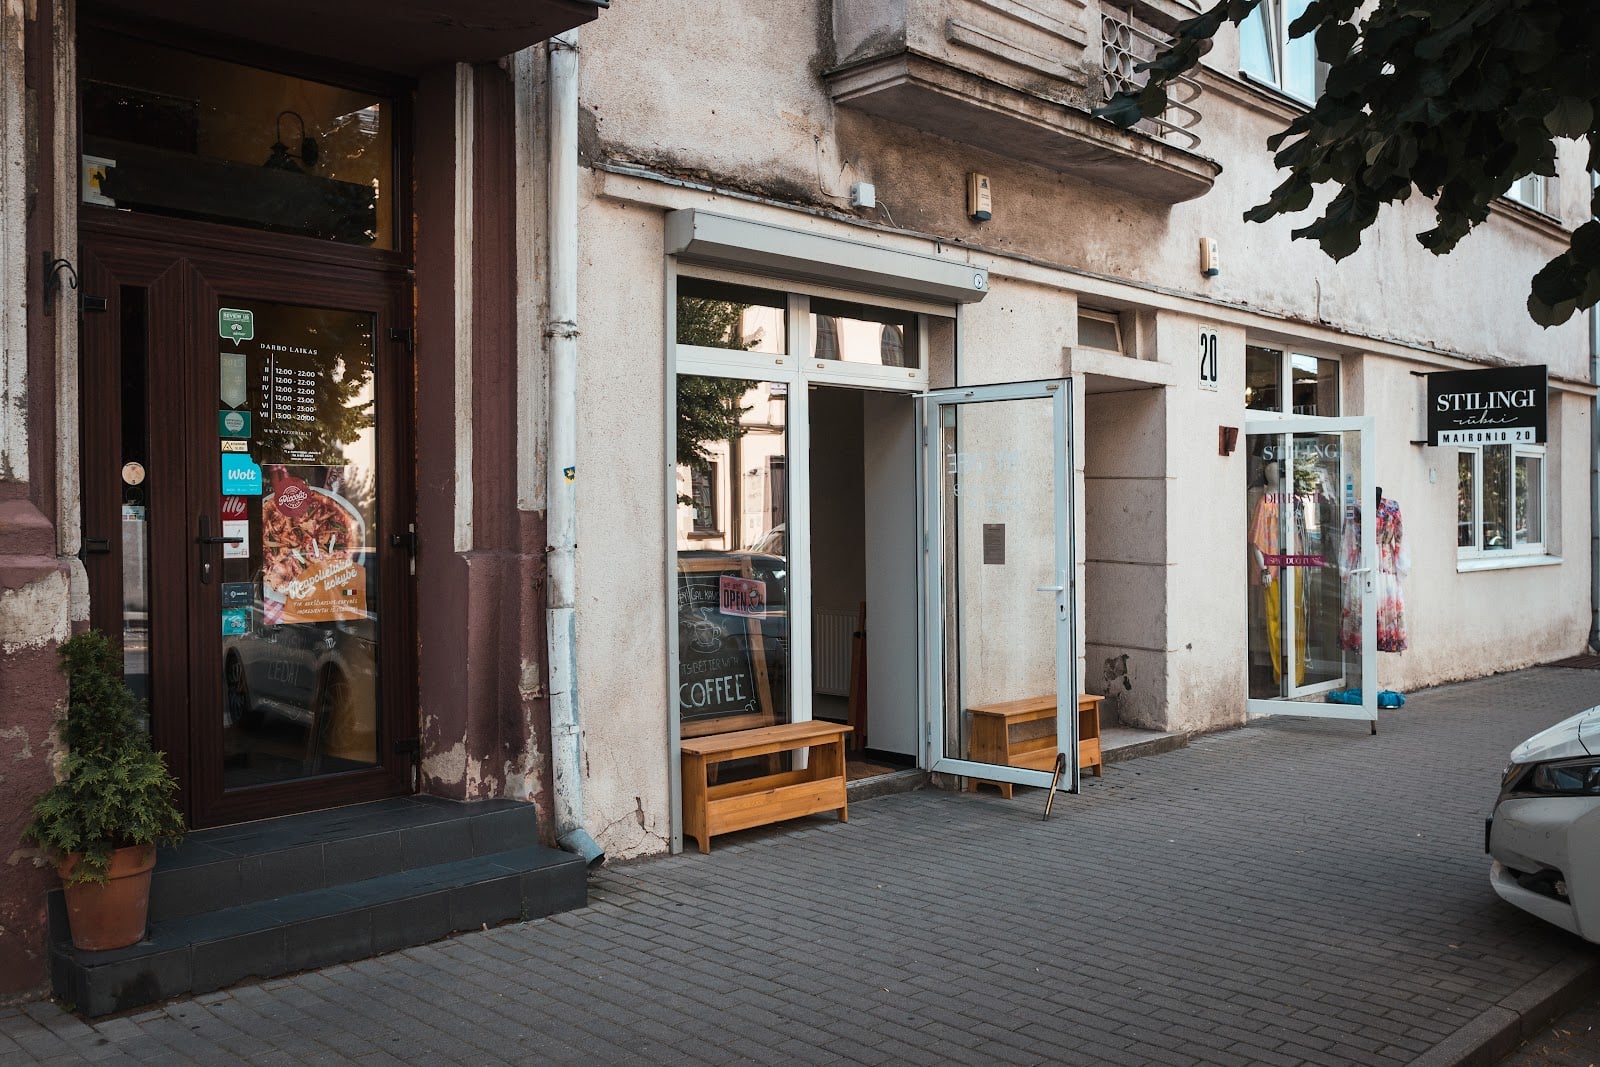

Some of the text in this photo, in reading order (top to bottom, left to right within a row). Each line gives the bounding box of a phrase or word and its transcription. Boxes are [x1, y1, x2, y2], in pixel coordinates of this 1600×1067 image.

[260, 343, 318, 355] DARBO LAIKAS
[1200, 333, 1217, 382] 20
[1437, 389, 1536, 412] STILINGI
[1443, 430, 1531, 443] MAIRONIO 20
[228, 468, 256, 480] Wolt
[222, 496, 246, 517] illy
[723, 589, 747, 611] OPEN
[692, 658, 721, 674] BETTER
[679, 673, 747, 708] COFFEE
